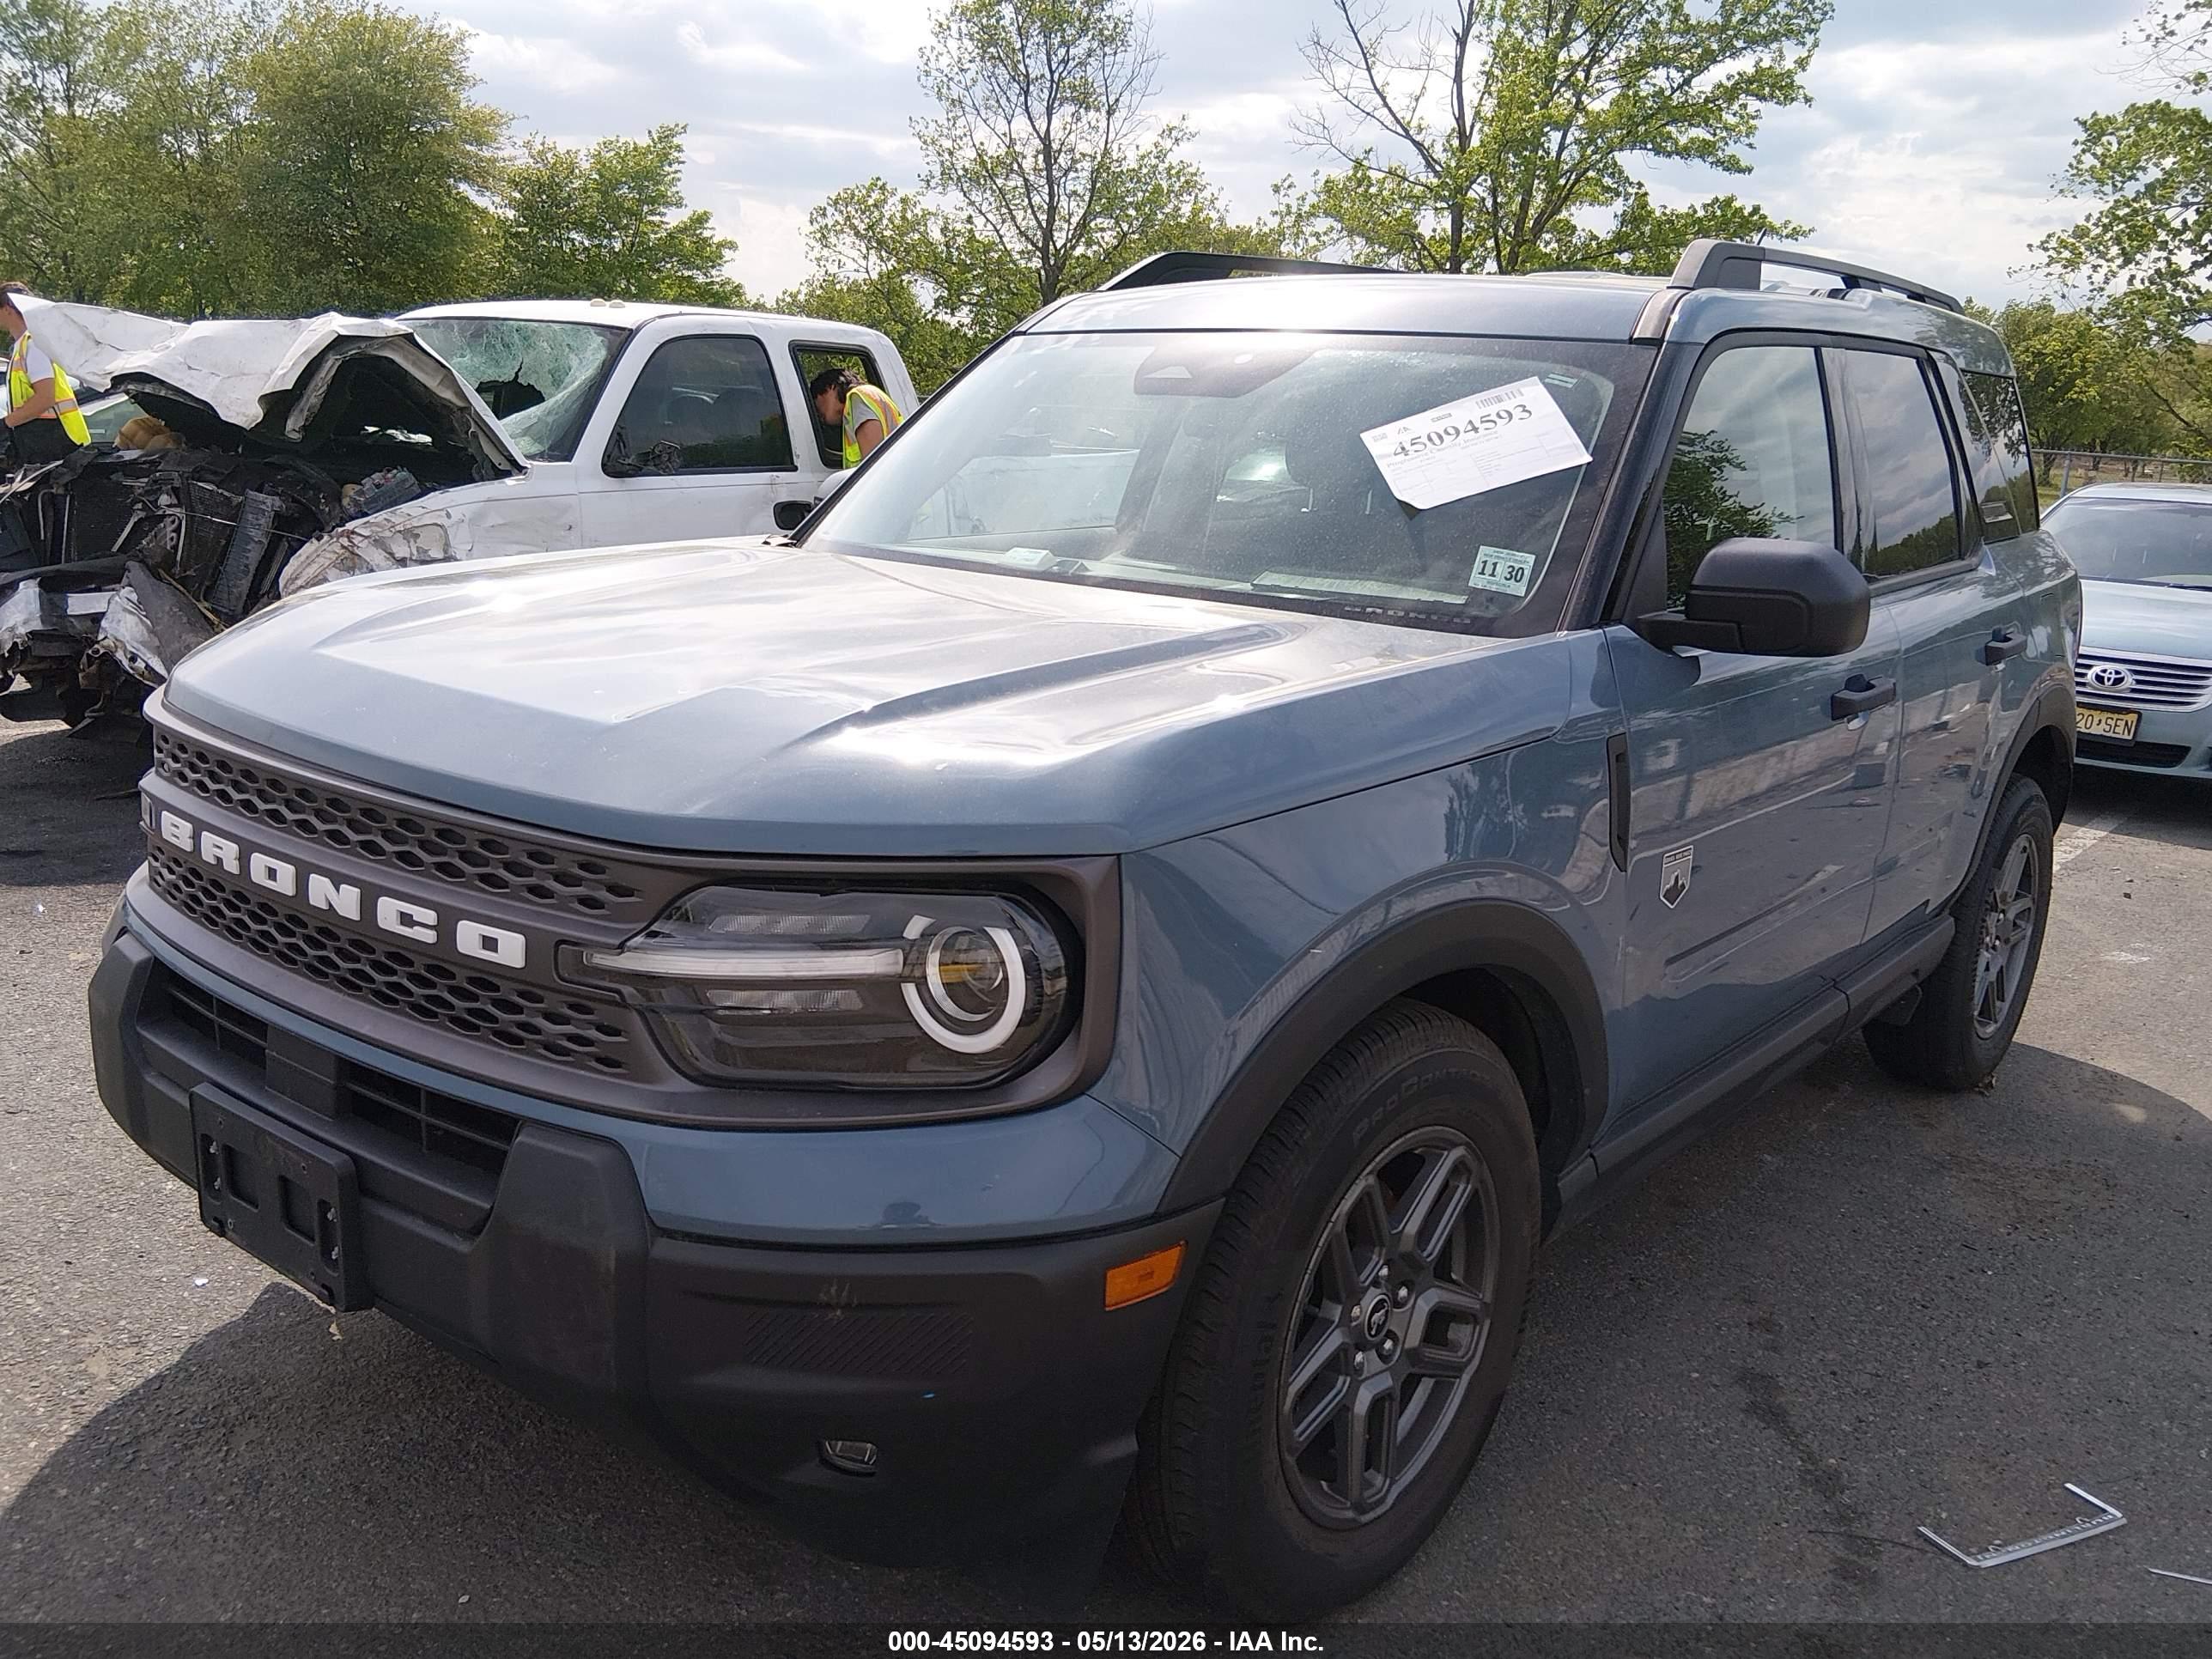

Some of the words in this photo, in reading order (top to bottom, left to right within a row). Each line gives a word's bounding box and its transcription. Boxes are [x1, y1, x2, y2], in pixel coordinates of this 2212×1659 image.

[1393, 404, 1533, 456] 45094593
[1478, 559, 1498, 578] 11
[1504, 564, 1525, 583] 30
[2103, 716, 2135, 737] SEN
[161, 810, 526, 969] BRONCO
